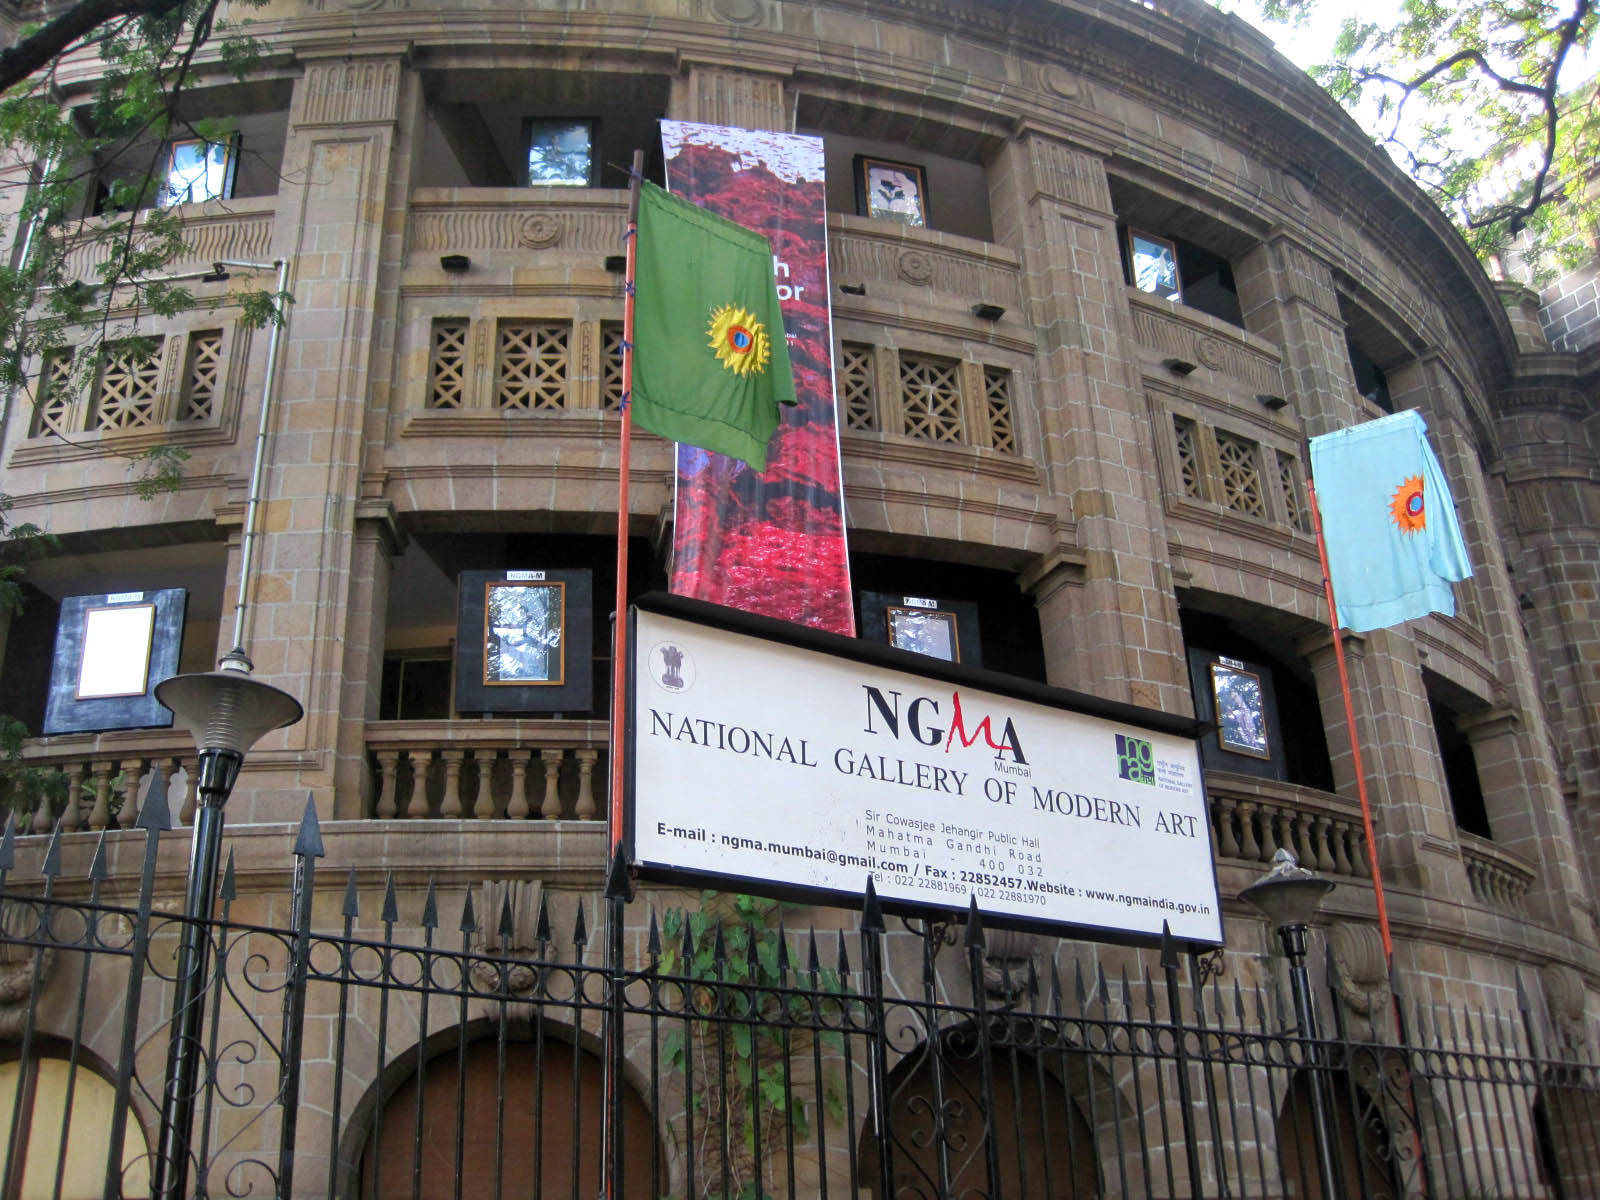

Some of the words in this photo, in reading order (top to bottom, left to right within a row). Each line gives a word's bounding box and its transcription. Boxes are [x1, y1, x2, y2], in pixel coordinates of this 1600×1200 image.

[862, 684, 1029, 766] NGMA
[648, 708, 818, 767] NATIONAL
[834, 748, 969, 796] GALLERY
[984, 777, 1017, 805] OF
[1032, 785, 1141, 829] MODERN
[1155, 811, 1198, 838] ART
[994, 761, 1032, 778] Mumbai
[865, 809, 881, 822] Sir
[886, 813, 936, 832] Cowasjee
[940, 822, 983, 841] Jehangir
[988, 830, 1017, 845] Public
[1022, 836, 1040, 849] Hall
[866, 825, 933, 846] Mahatma
[946, 838, 997, 856] Gandhi
[1008, 848, 1042, 863] Road
[657, 822, 706, 842] E-mail
[721, 833, 908, 874] ngma.mumbai@gmail.com
[925, 864, 948, 879] Fax
[1085, 889, 1210, 915] www.ngmaindia.gov.in
[867, 840, 926, 860] Mumbai
[979, 858, 1005, 872] 400
[1018, 864, 1044, 878] 032
[895, 874, 914, 887] 022
[918, 877, 967, 895] 22881969
[977, 887, 996, 899] 022
[1000, 889, 1047, 906] 22881970
